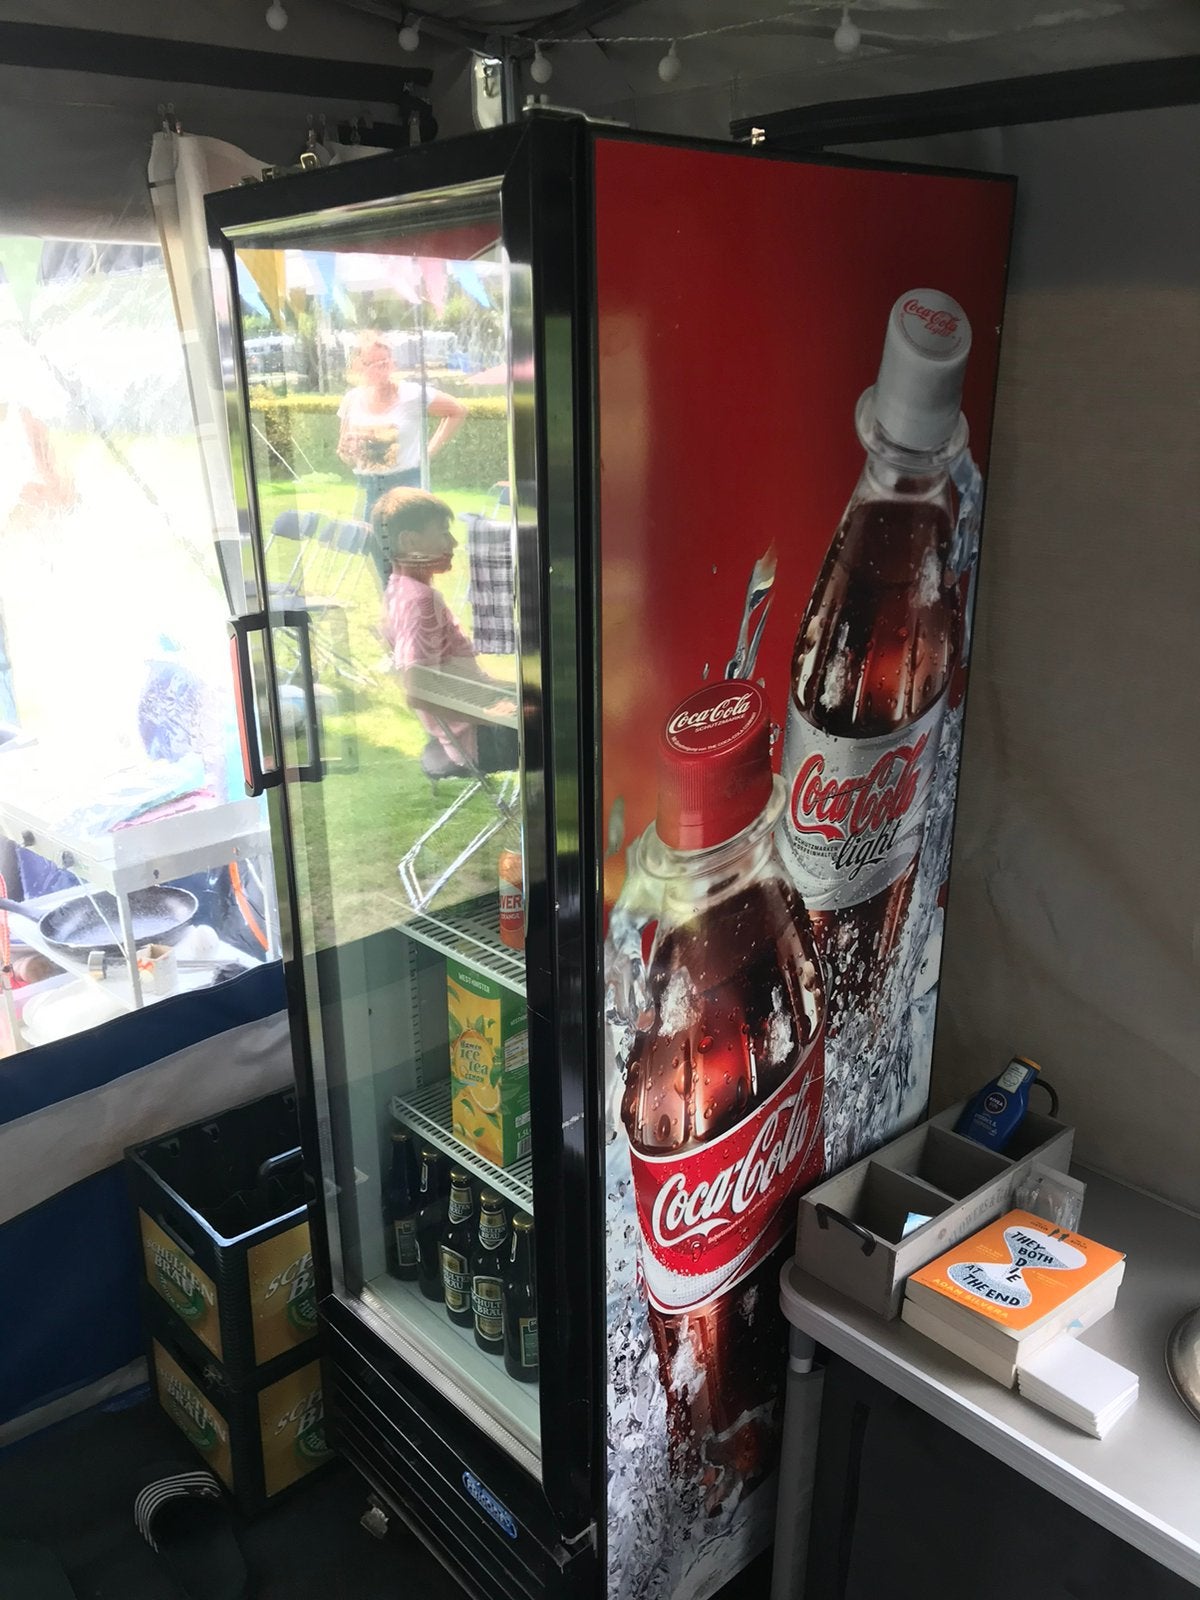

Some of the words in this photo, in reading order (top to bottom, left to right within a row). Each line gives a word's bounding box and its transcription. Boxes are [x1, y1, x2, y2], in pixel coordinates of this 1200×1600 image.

[668, 691, 754, 734] Coca-Cola
[832, 818, 902, 881] light
[652, 1070, 812, 1248] Coca-Cola
[1010, 1230, 1047, 1251] THEY
[1017, 1247, 1054, 1265] BOTH
[965, 1264, 984, 1275] AT
[962, 1273, 990, 1293] THE
[985, 1288, 1021, 1307] END
